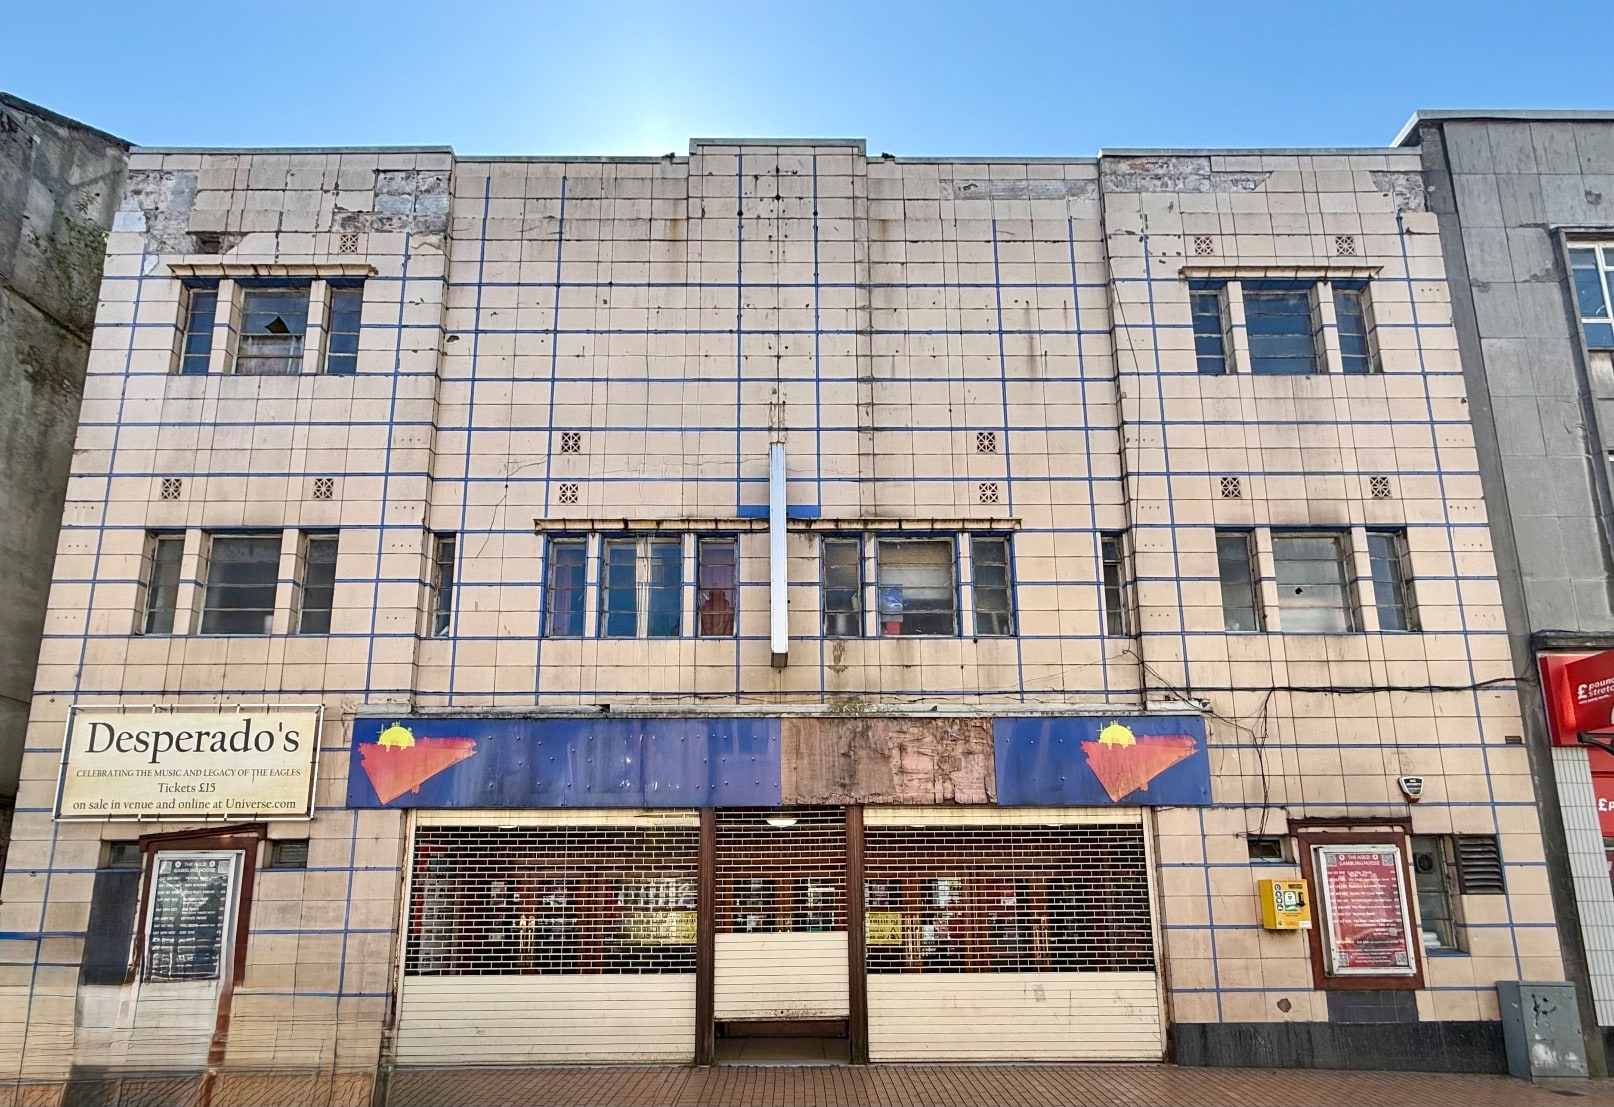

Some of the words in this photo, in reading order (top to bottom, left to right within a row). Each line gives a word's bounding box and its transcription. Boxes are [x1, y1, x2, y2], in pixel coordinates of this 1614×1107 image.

[84, 718, 300, 764] Desperado's
[76, 769, 134, 778] CELEBRATING
[135, 769, 153, 777] THE
[154, 769, 182, 777] MUSIC
[183, 769, 202, 777] AND
[203, 769, 237, 777] LEGACY
[237, 769, 250, 777] OF
[251, 769, 269, 783] THE
[269, 768, 301, 777] EAGLES
[157, 782, 196, 793] Tickets
[198, 782, 216, 793] £15
[73, 801, 86, 809] on
[88, 799, 109, 809] sale
[110, 799, 121, 809] in
[123, 801, 154, 809] venue
[155, 798, 175, 809] and
[178, 798, 210, 809] online
[212, 800, 223, 809] at
[226, 798, 296, 809] Universe.com
